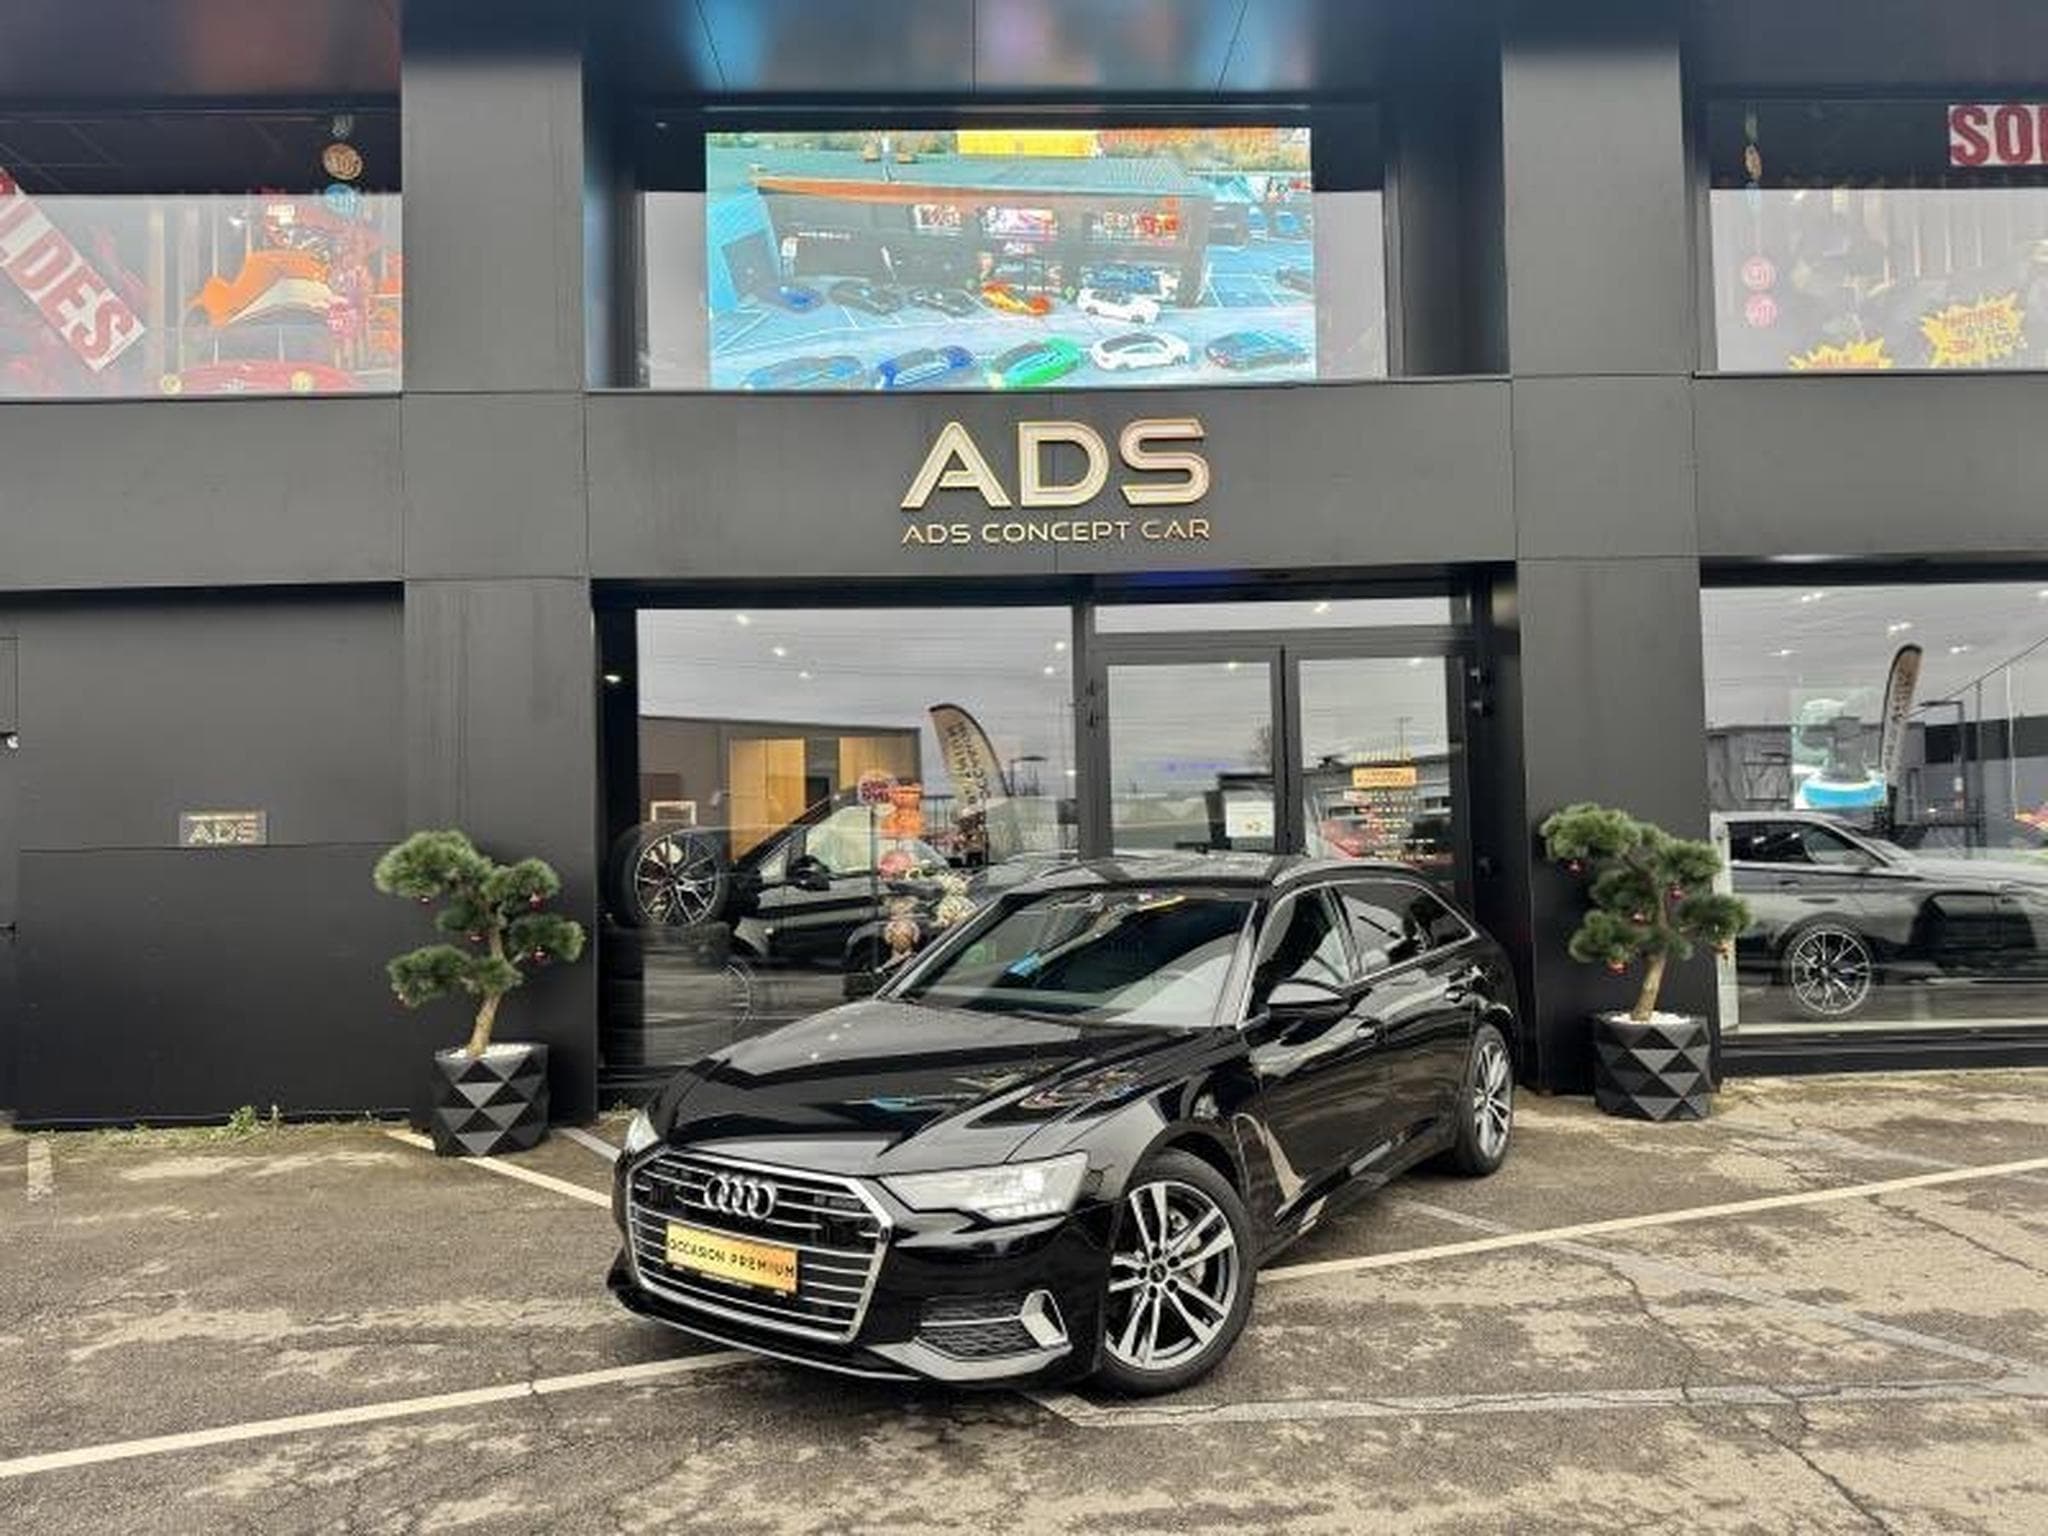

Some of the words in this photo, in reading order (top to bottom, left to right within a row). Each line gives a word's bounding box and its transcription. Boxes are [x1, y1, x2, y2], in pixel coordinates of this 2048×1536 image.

[1951, 105, 2048, 165] SO
[0, 170, 136, 360] LDES
[901, 418, 1210, 508] ADS
[902, 524, 971, 544] ADS
[982, 520, 1130, 543] CONCEPT
[1140, 518, 1210, 540] CAR
[669, 1238, 726, 1262] OCCASION
[730, 1253, 795, 1278] PREMIUM
